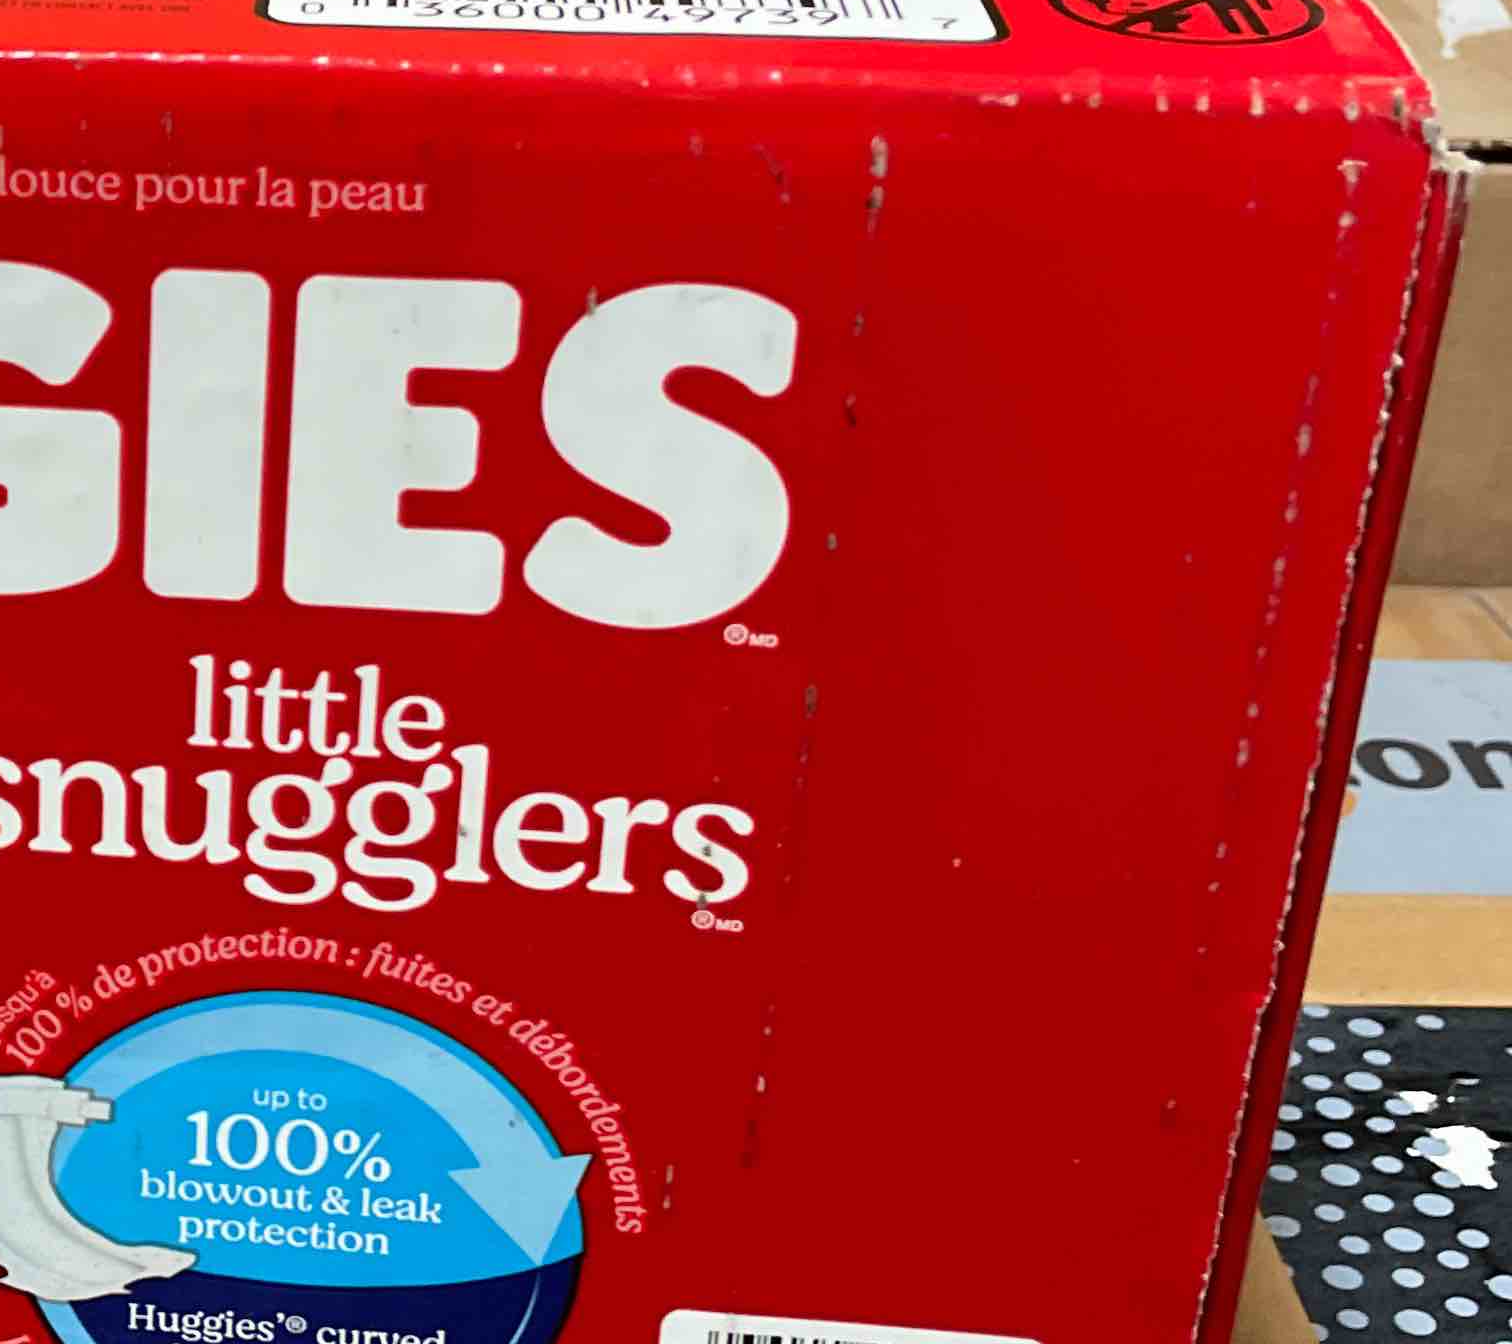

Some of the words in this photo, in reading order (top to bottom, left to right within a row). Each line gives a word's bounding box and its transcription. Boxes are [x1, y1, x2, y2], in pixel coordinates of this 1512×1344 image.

[300, 1, 326, 15] 0
[413, 0, 607, 22] 36000
[641, 6, 843, 26] 49739
[931, 17, 959, 30] 7
[134, 169, 246, 211] pour
[256, 167, 295, 208] la
[308, 176, 426, 218] peau
[188, 655, 446, 762] little
[5, 1009, 63, 1068] 100
[55, 985, 94, 1020] %
[92, 963, 137, 999] de
[137, 926, 339, 987] protection
[362, 941, 472, 1004] fuites
[471, 994, 513, 1026] et
[508, 1019, 649, 1234] débordements
[251, 1088, 290, 1112] up
[296, 1087, 328, 1112] to
[185, 1109, 392, 1183] 100%
[140, 1167, 314, 1213] blowout
[320, 1185, 351, 1216] &
[360, 1187, 443, 1225] leak
[177, 1215, 390, 1256] protection
